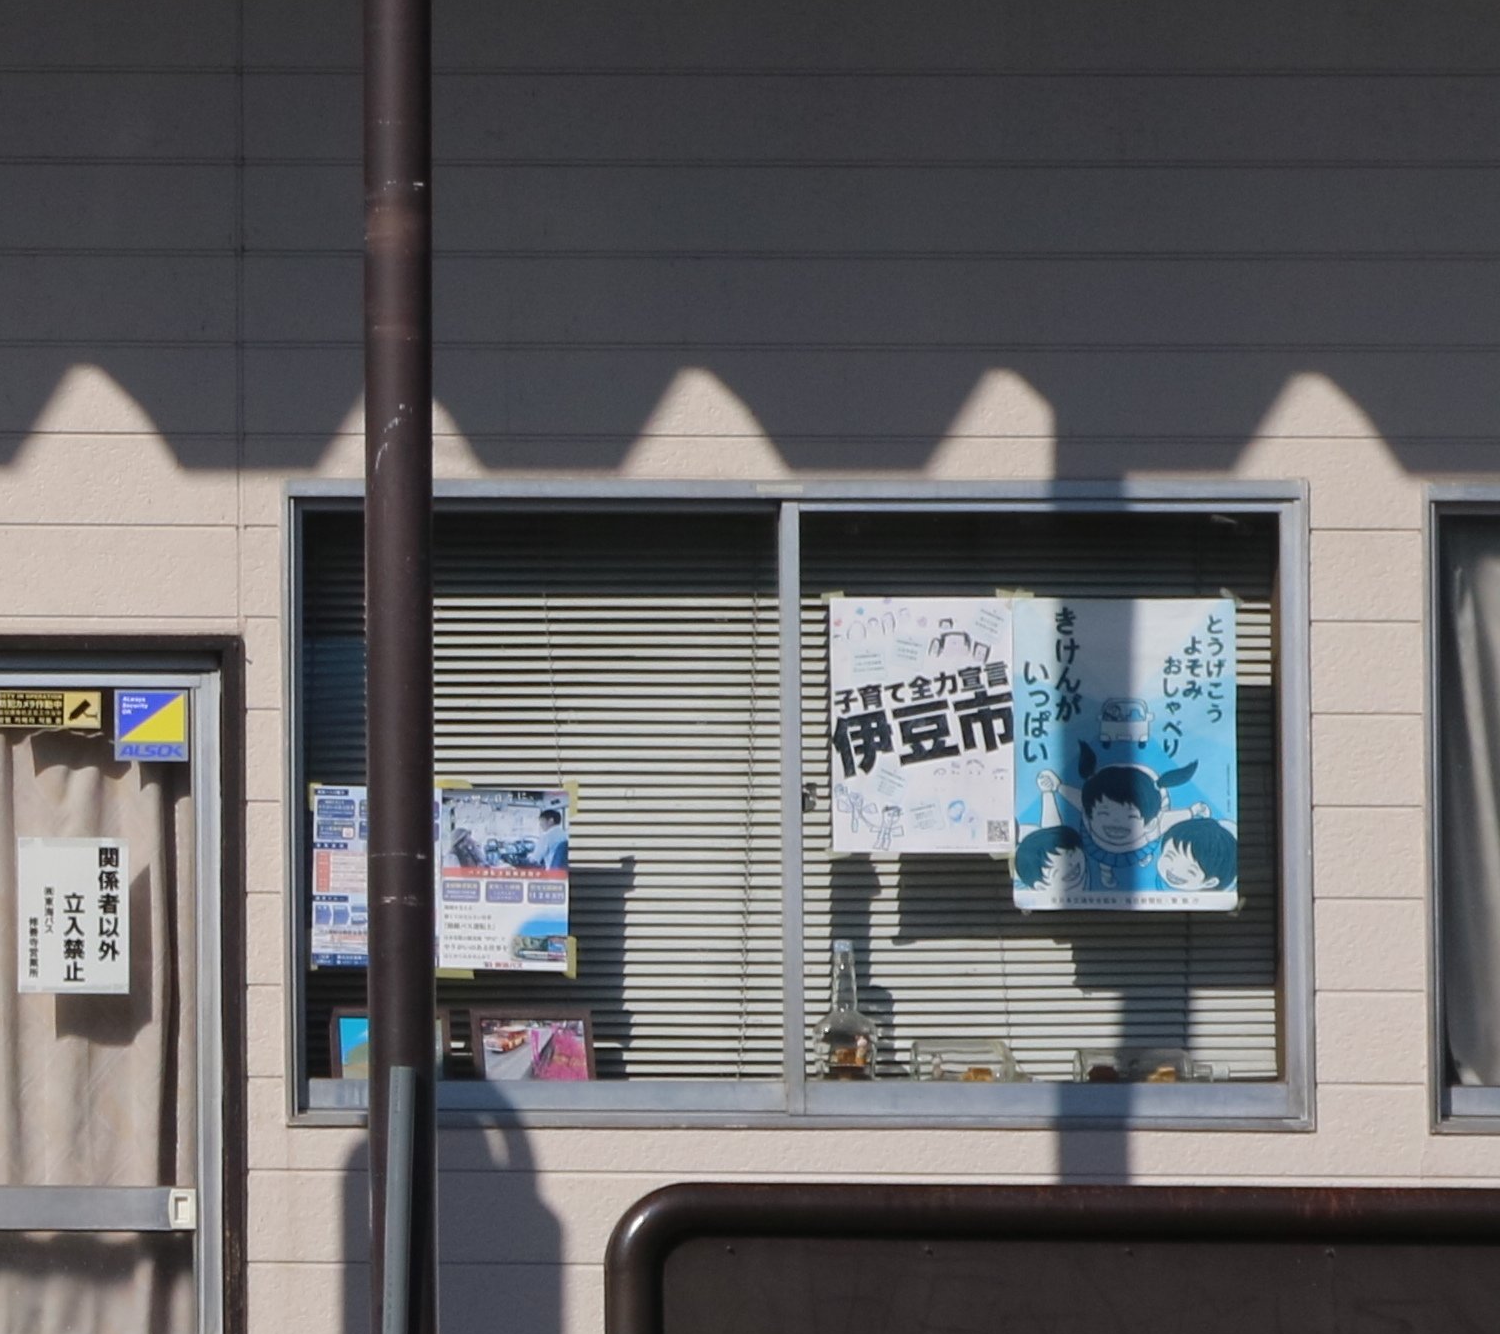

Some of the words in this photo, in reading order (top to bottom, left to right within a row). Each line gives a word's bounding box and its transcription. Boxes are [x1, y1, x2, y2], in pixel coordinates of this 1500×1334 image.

[834, 661, 1008, 714] 子育て全力宣言
[1023, 661, 1051, 763] いっぱい
[1055, 606, 1082, 722] きけんが
[1163, 656, 1182, 758] おしゃべり
[1183, 636, 1203, 700] よそみ
[1206, 614, 1225, 723] とうげこう
[120, 745, 182, 757] ALSOK
[832, 691, 1014, 778] 伊豆市
[63, 892, 85, 982] 立入禁止
[98, 847, 120, 961] 関係者以外
